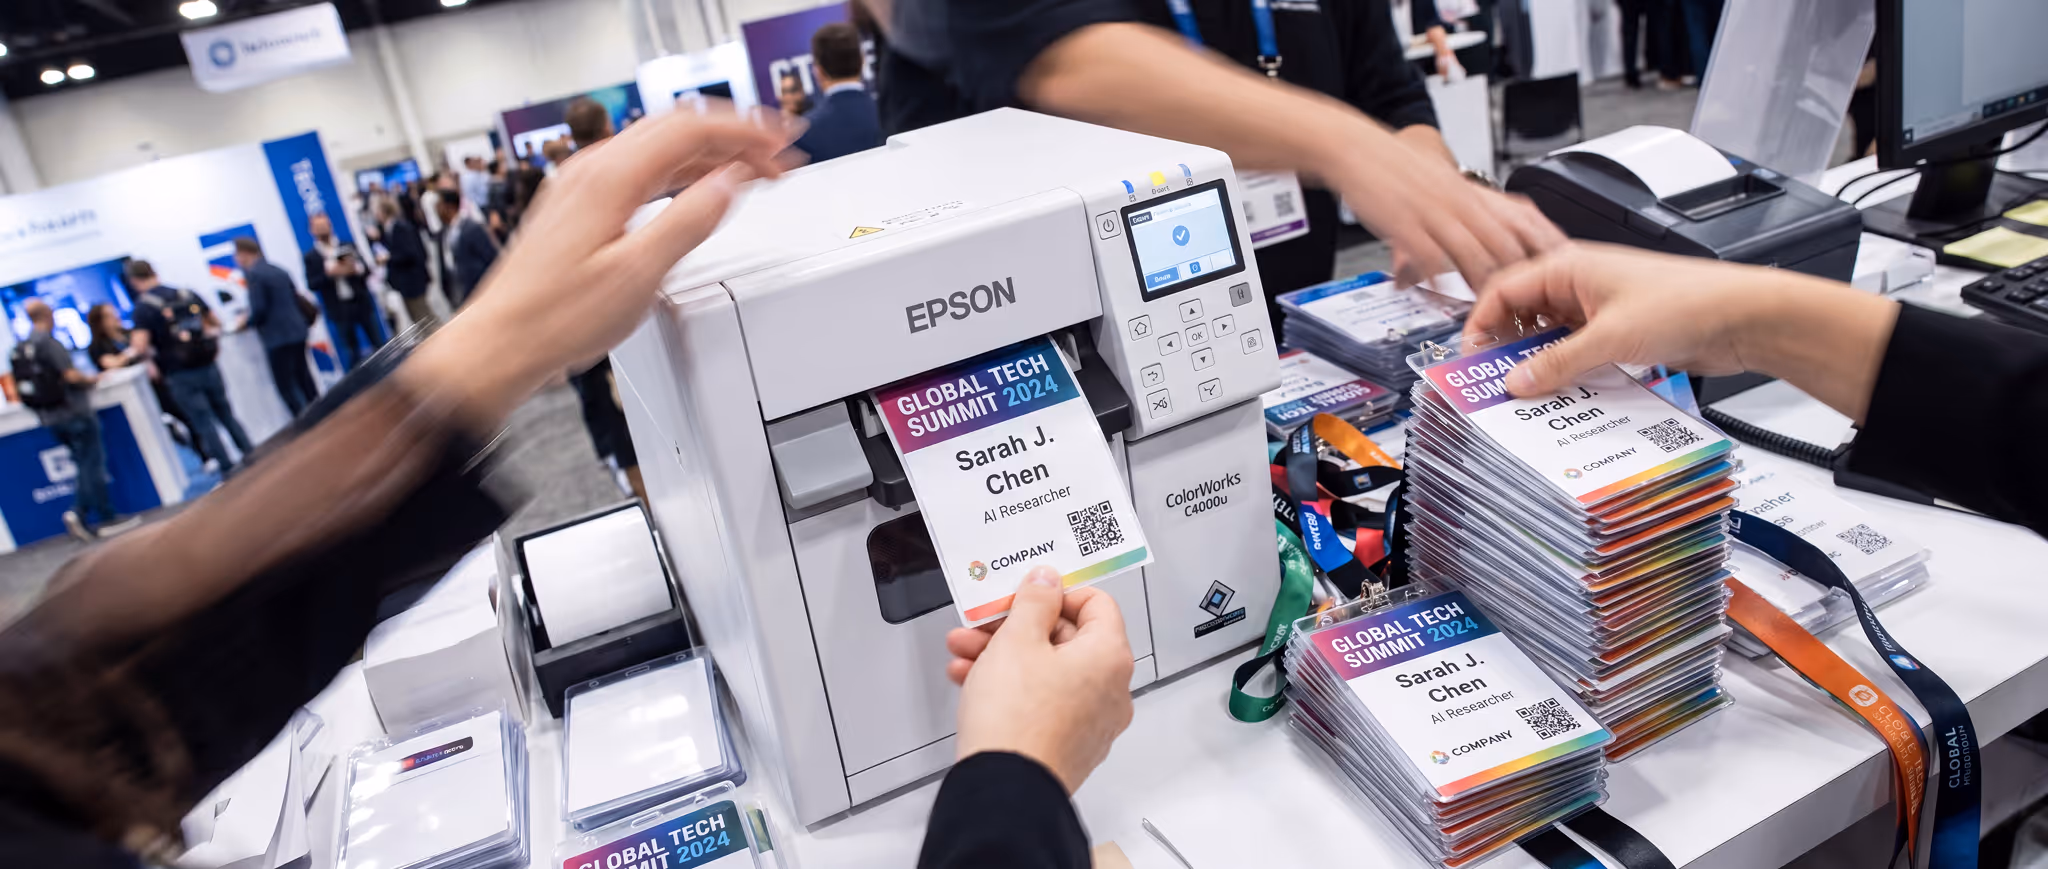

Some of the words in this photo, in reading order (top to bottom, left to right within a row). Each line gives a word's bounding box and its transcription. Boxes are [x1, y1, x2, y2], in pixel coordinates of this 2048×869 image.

[906, 277, 1016, 334] EPSON
[1192, 331, 1203, 341] OK
[897, 374, 988, 416] GLOBAL
[987, 354, 1050, 386] TECH
[907, 393, 999, 437] SUMMIT
[1002, 374, 1059, 407] 2024
[1514, 394, 1575, 421] Sarah
[1577, 387, 1599, 399] J.
[1547, 405, 1605, 432] Chen
[1556, 436, 1570, 448] AI
[1571, 415, 1632, 443] Researcher
[956, 435, 1027, 471] Sarah
[1033, 426, 1054, 447] J.
[1583, 447, 1638, 473] COMPANY
[986, 463, 1050, 495] Chen
[1166, 473, 1241, 508] ColorWorks
[983, 510, 997, 524] AI
[1001, 486, 1072, 519] Researcher
[1184, 495, 1228, 517] C4000u
[991, 541, 1055, 571] COMPANY
[1331, 624, 1414, 654] GLOBAL
[1409, 601, 1465, 629] TECH
[1344, 632, 1426, 669] SUMMIT
[1427, 615, 1479, 643] 2024
[1395, 662, 1460, 688] Sarah
[1465, 653, 1485, 667] J.
[1428, 676, 1488, 703] Chen
[1431, 713, 1445, 725] AI
[1448, 689, 1515, 720] Researcher
[1451, 730, 1514, 757] COMPANY
[668, 813, 726, 845] TECH
[677, 831, 731, 864] 2024
